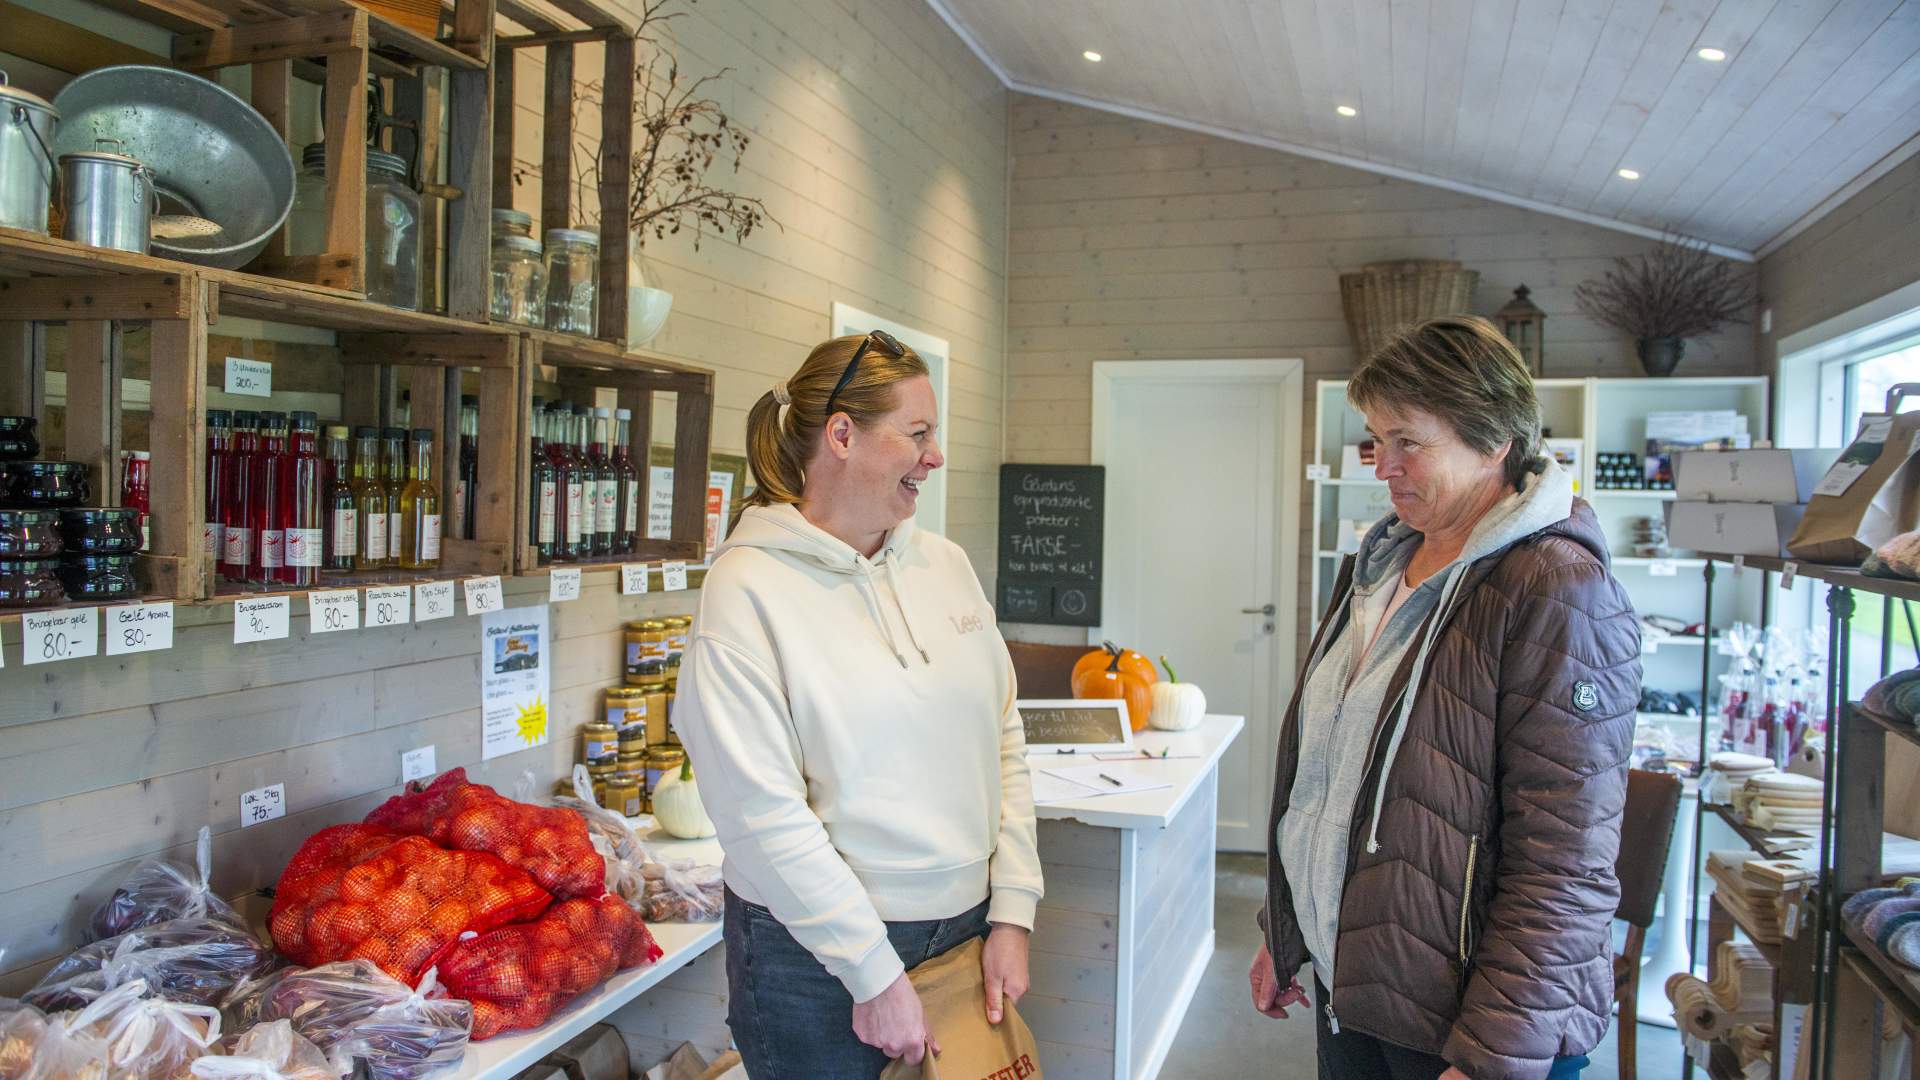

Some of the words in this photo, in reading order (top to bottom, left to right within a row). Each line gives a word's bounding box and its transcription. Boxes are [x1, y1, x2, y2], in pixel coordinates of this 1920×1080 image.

[324, 606, 351, 630] 80,-
[42, 632, 83, 659] 80,-
[123, 628, 152, 647] 80,-
